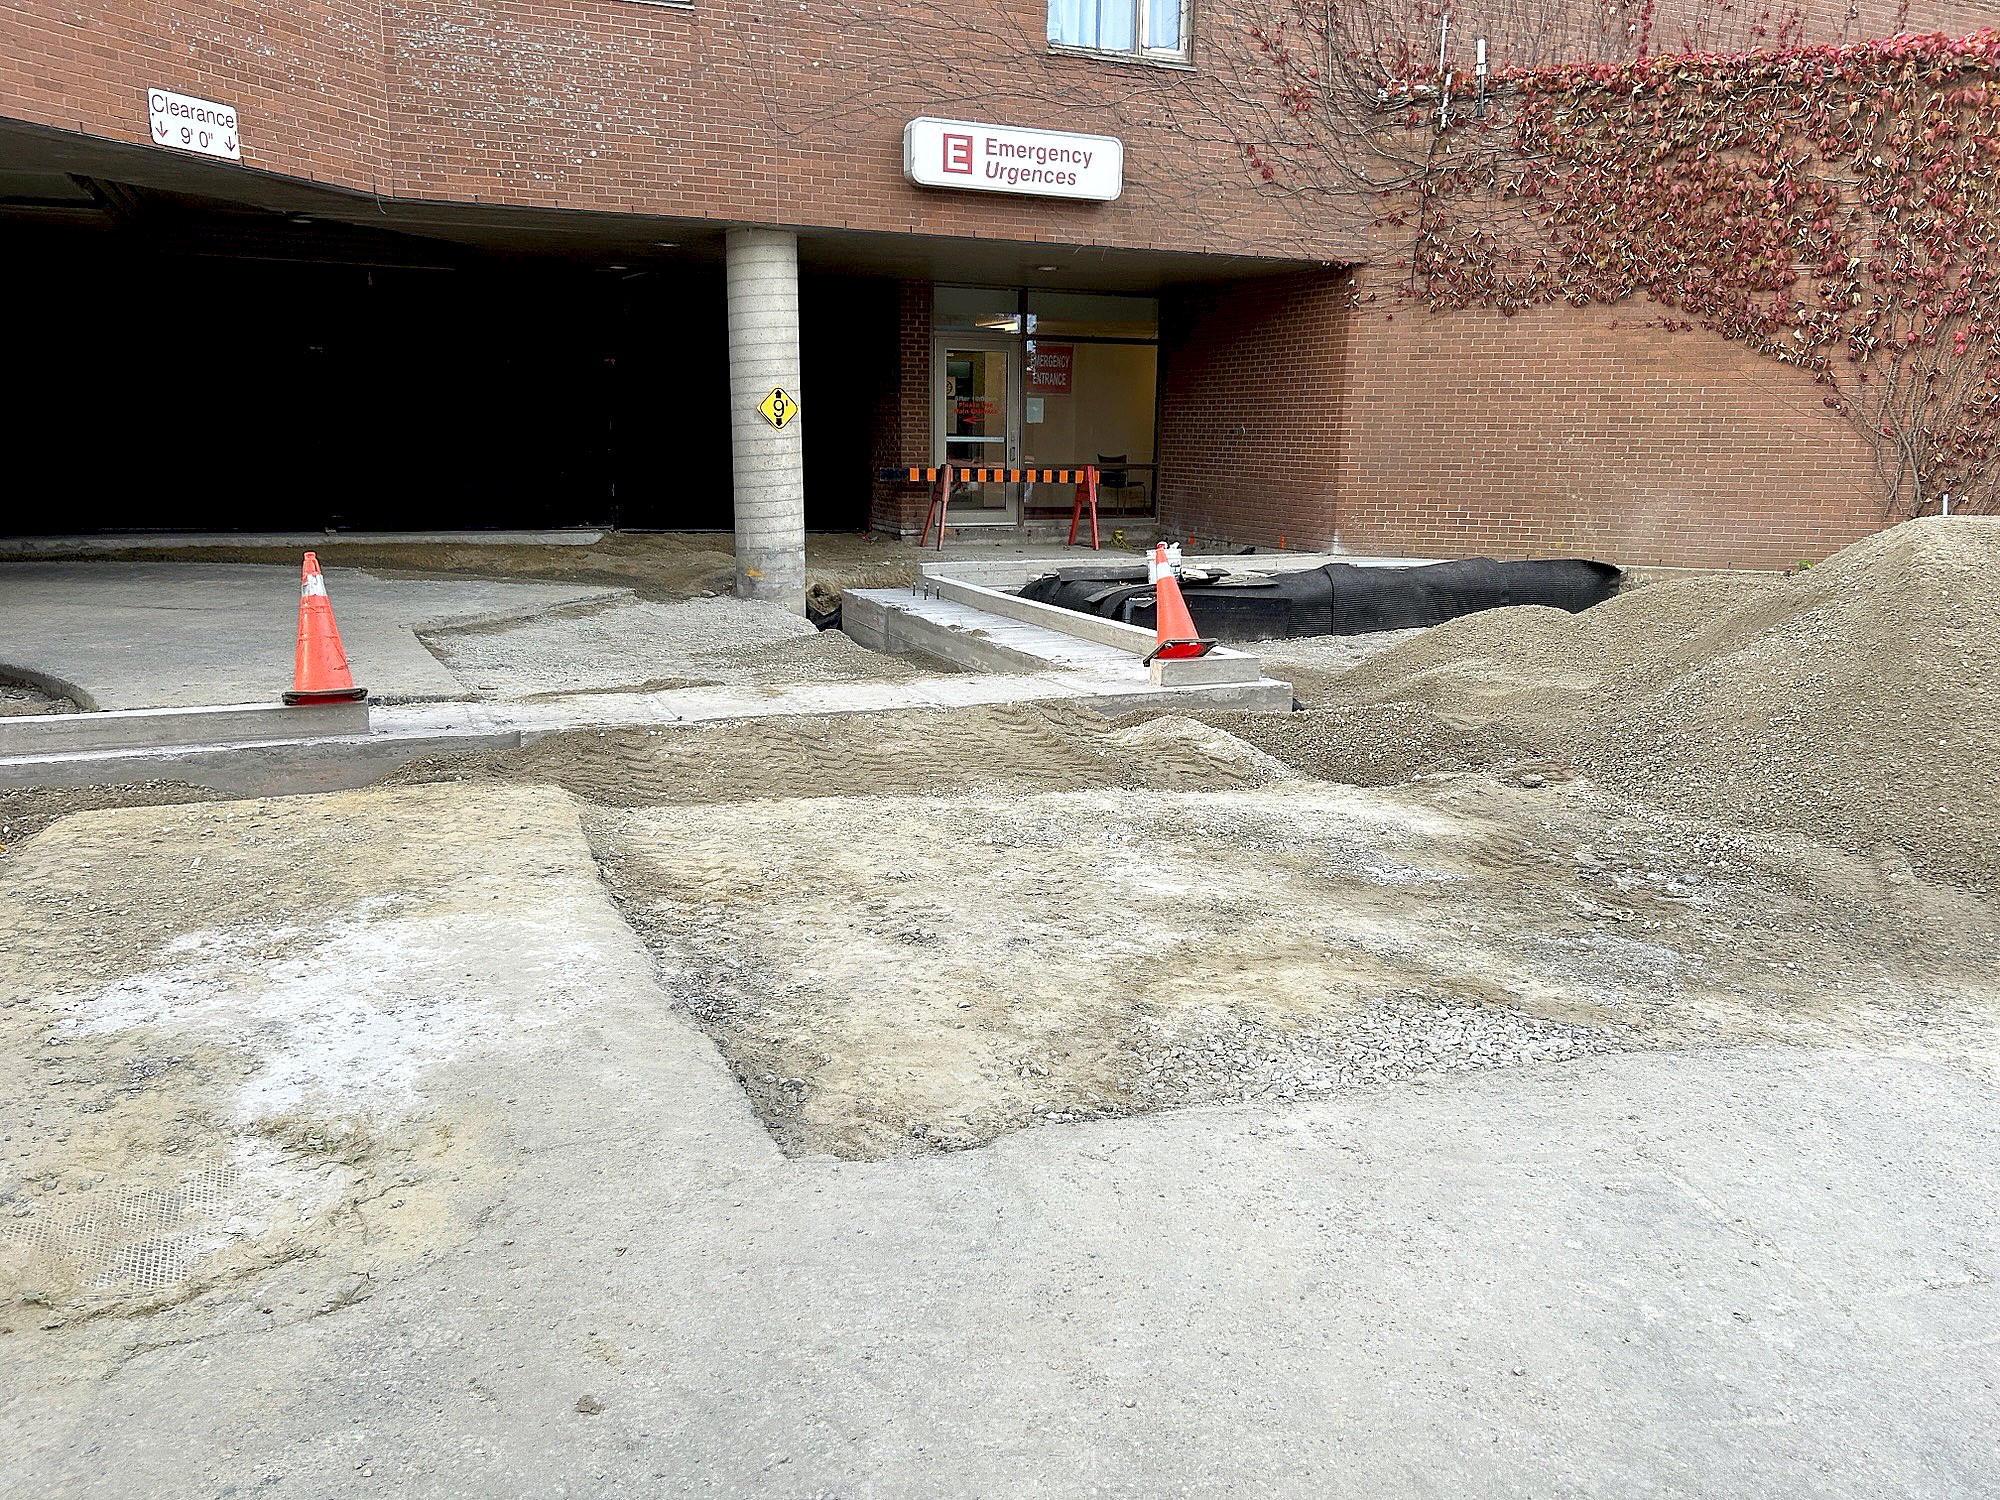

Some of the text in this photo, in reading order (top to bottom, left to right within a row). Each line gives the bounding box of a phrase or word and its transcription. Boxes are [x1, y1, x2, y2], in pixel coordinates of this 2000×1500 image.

[151, 94, 235, 129] Clearance
[947, 136, 970, 172] E
[985, 138, 1093, 169] Emergency
[985, 160, 1077, 186] Urgences
[1032, 372, 1067, 386] ENTRANCE
